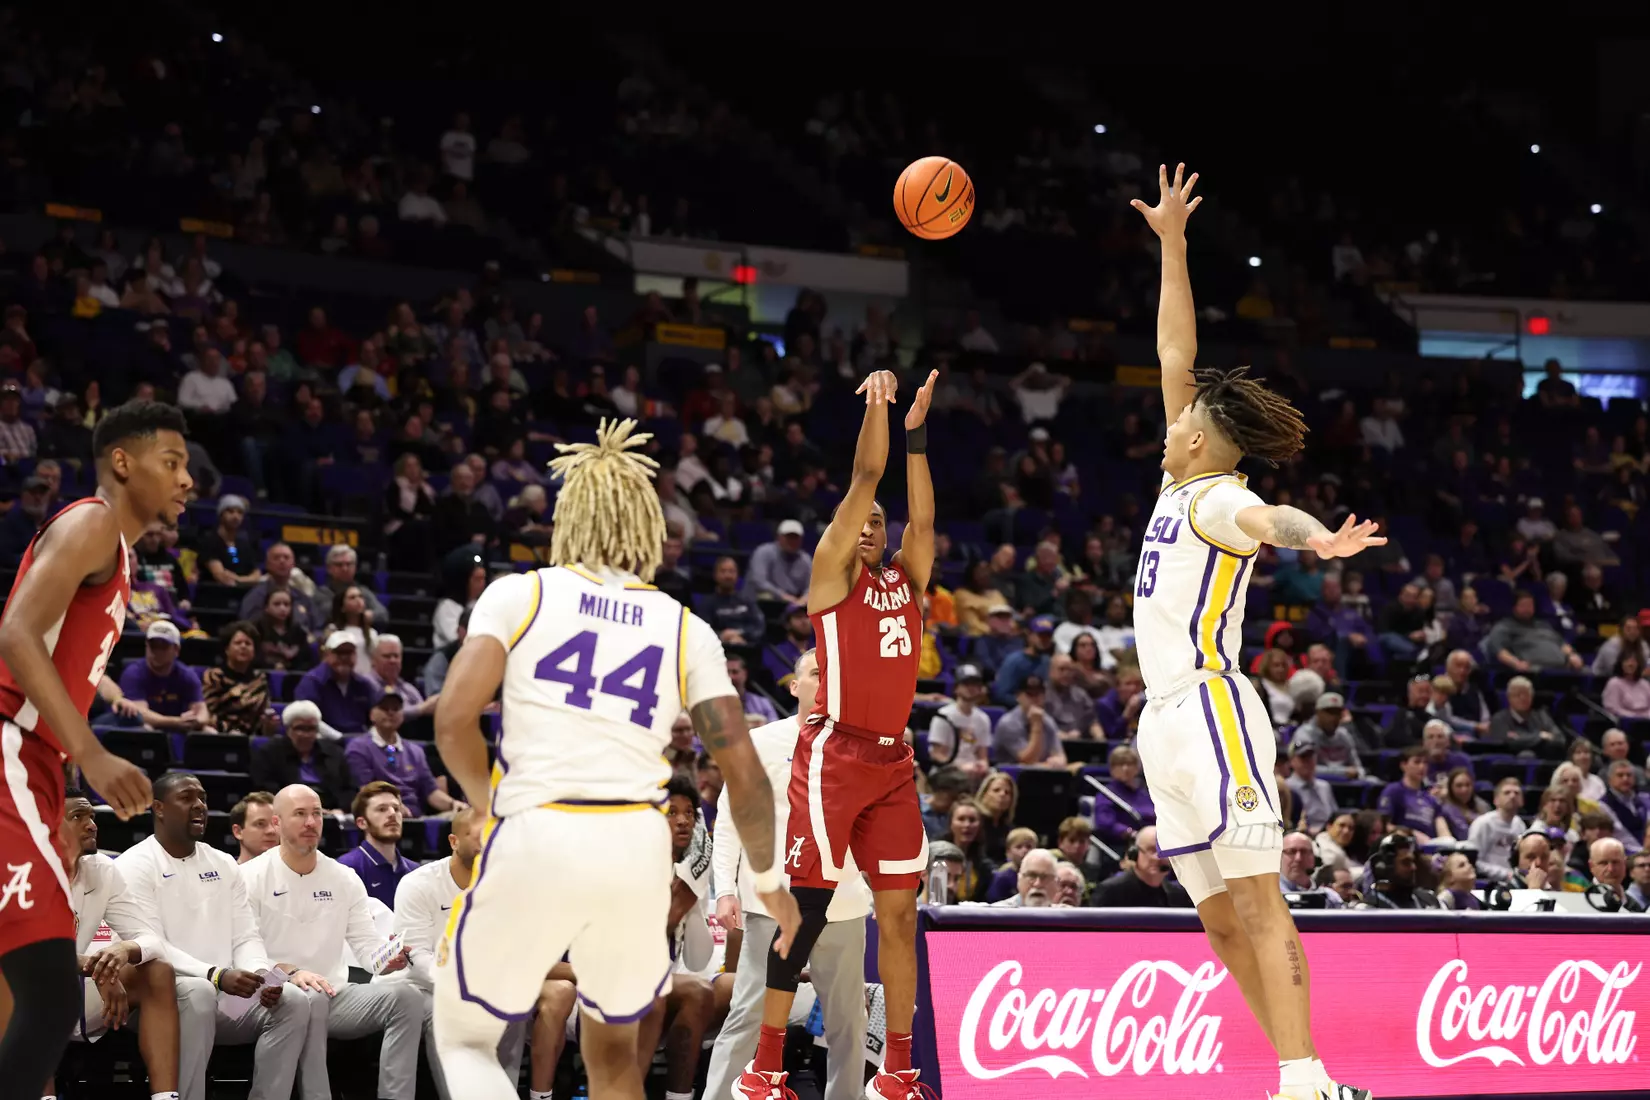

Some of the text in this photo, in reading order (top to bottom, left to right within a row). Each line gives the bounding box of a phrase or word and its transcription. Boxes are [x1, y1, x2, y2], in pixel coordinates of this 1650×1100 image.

[1144, 515, 1183, 545] SU
[1137, 551, 1160, 598] 13
[578, 592, 644, 627] MILLER
[879, 615, 912, 658] 25
[534, 630, 664, 730] 44
[199, 871, 219, 880] LSU
[959, 959, 1229, 1080] Coca-Cola
[1416, 958, 1644, 1069] Coca-Cola
